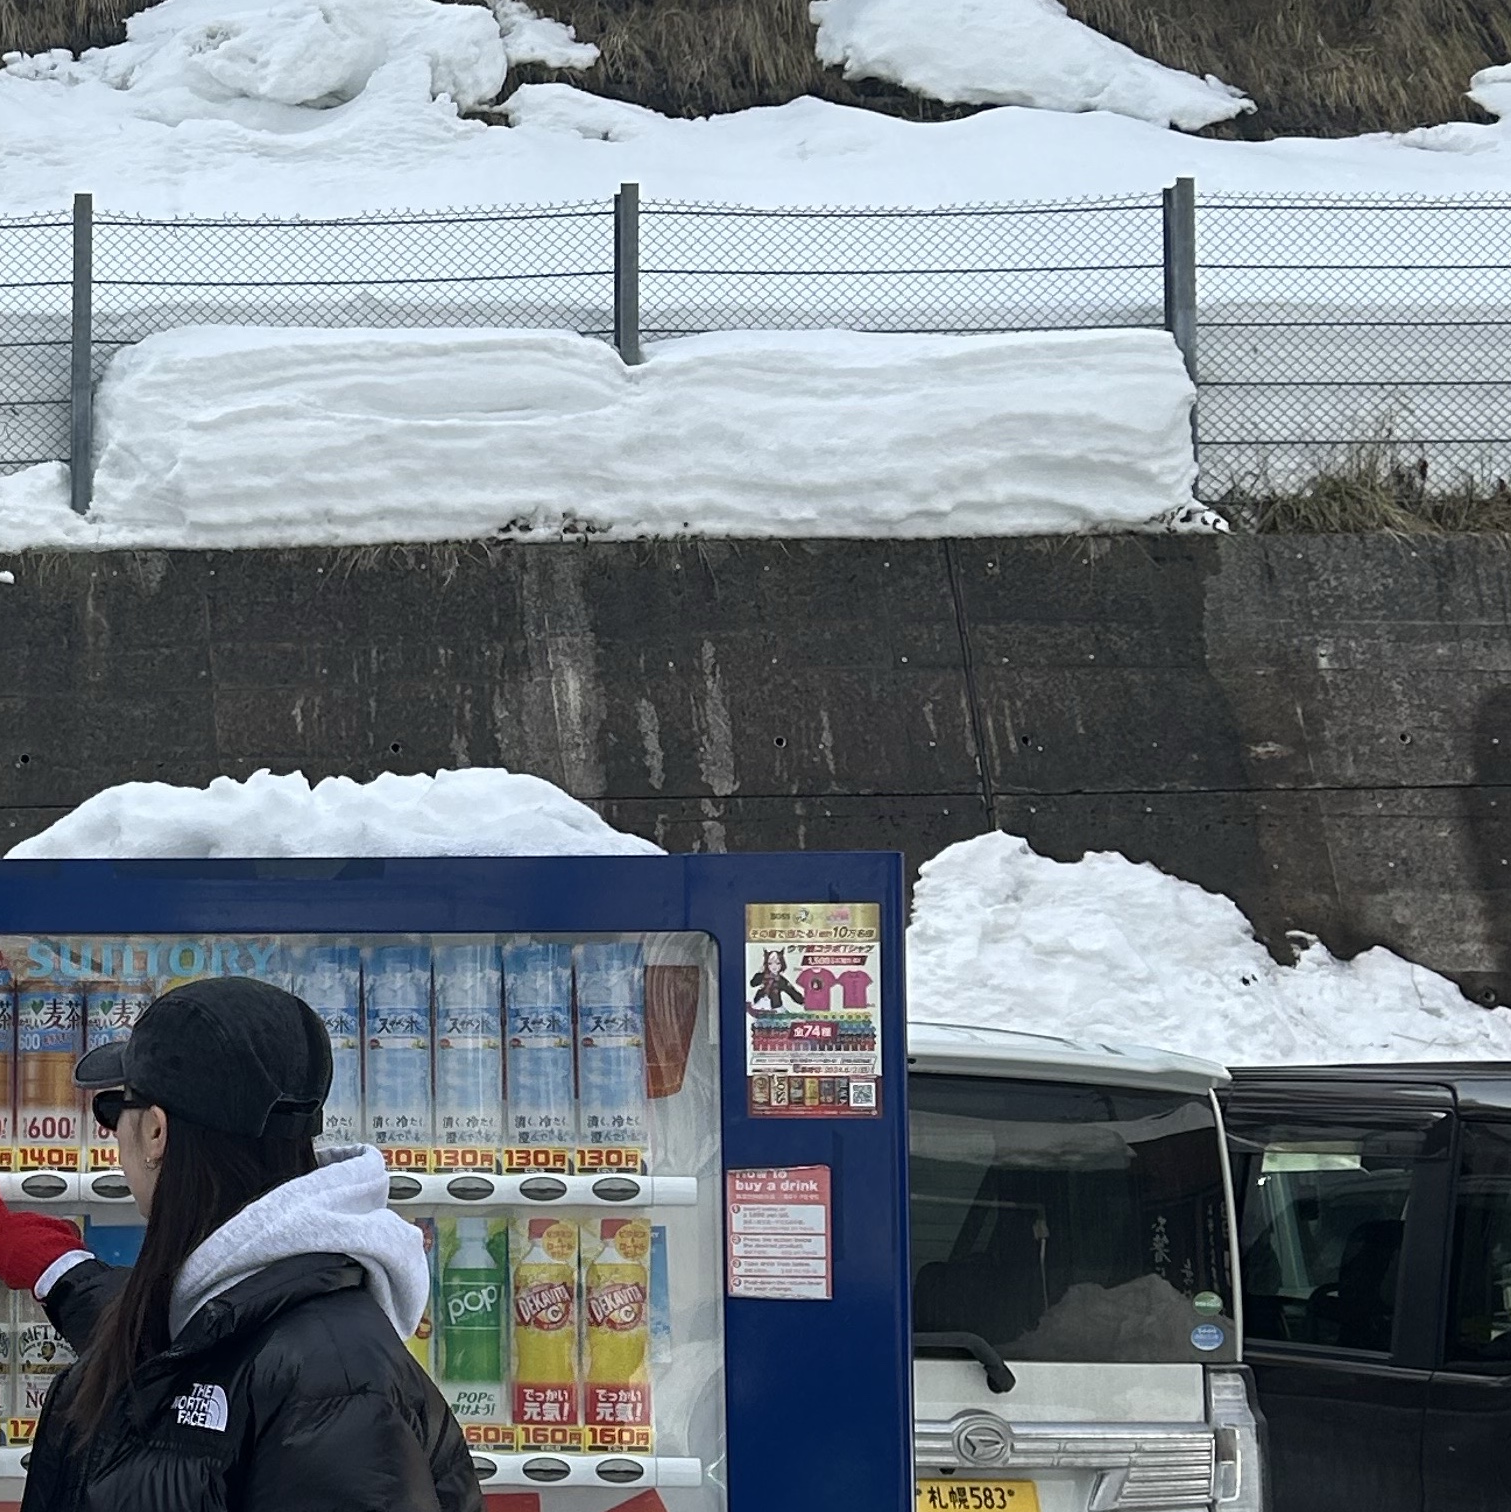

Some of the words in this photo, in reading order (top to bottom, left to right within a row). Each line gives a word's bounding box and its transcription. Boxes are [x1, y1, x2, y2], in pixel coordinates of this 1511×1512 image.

[26, 940, 276, 978] SUNTORY
[28, 1116, 71, 1139] 600
[19, 1148, 78, 1165] 140円
[432, 1150, 494, 1166] 130円
[505, 1150, 566, 1166] 130円
[576, 1150, 638, 1166] 130円
[735, 1180, 762, 1192] buy
[780, 1180, 818, 1191] drink
[448, 1285, 497, 1325] pop
[518, 1284, 571, 1322] DEKAVITA
[591, 1284, 642, 1323] DEKAVITA
[191, 1383, 213, 1398] THE
[523, 1389, 568, 1400] でっかい
[596, 1389, 641, 1400] でっかい
[170, 1395, 210, 1412] NORTH
[176, 1410, 206, 1426] FACE
[523, 1404, 569, 1421] 元気!
[596, 1404, 642, 1422] 元気!
[465, 1427, 514, 1443] 60円
[522, 1428, 582, 1444] 160円
[589, 1428, 649, 1445] 160円
